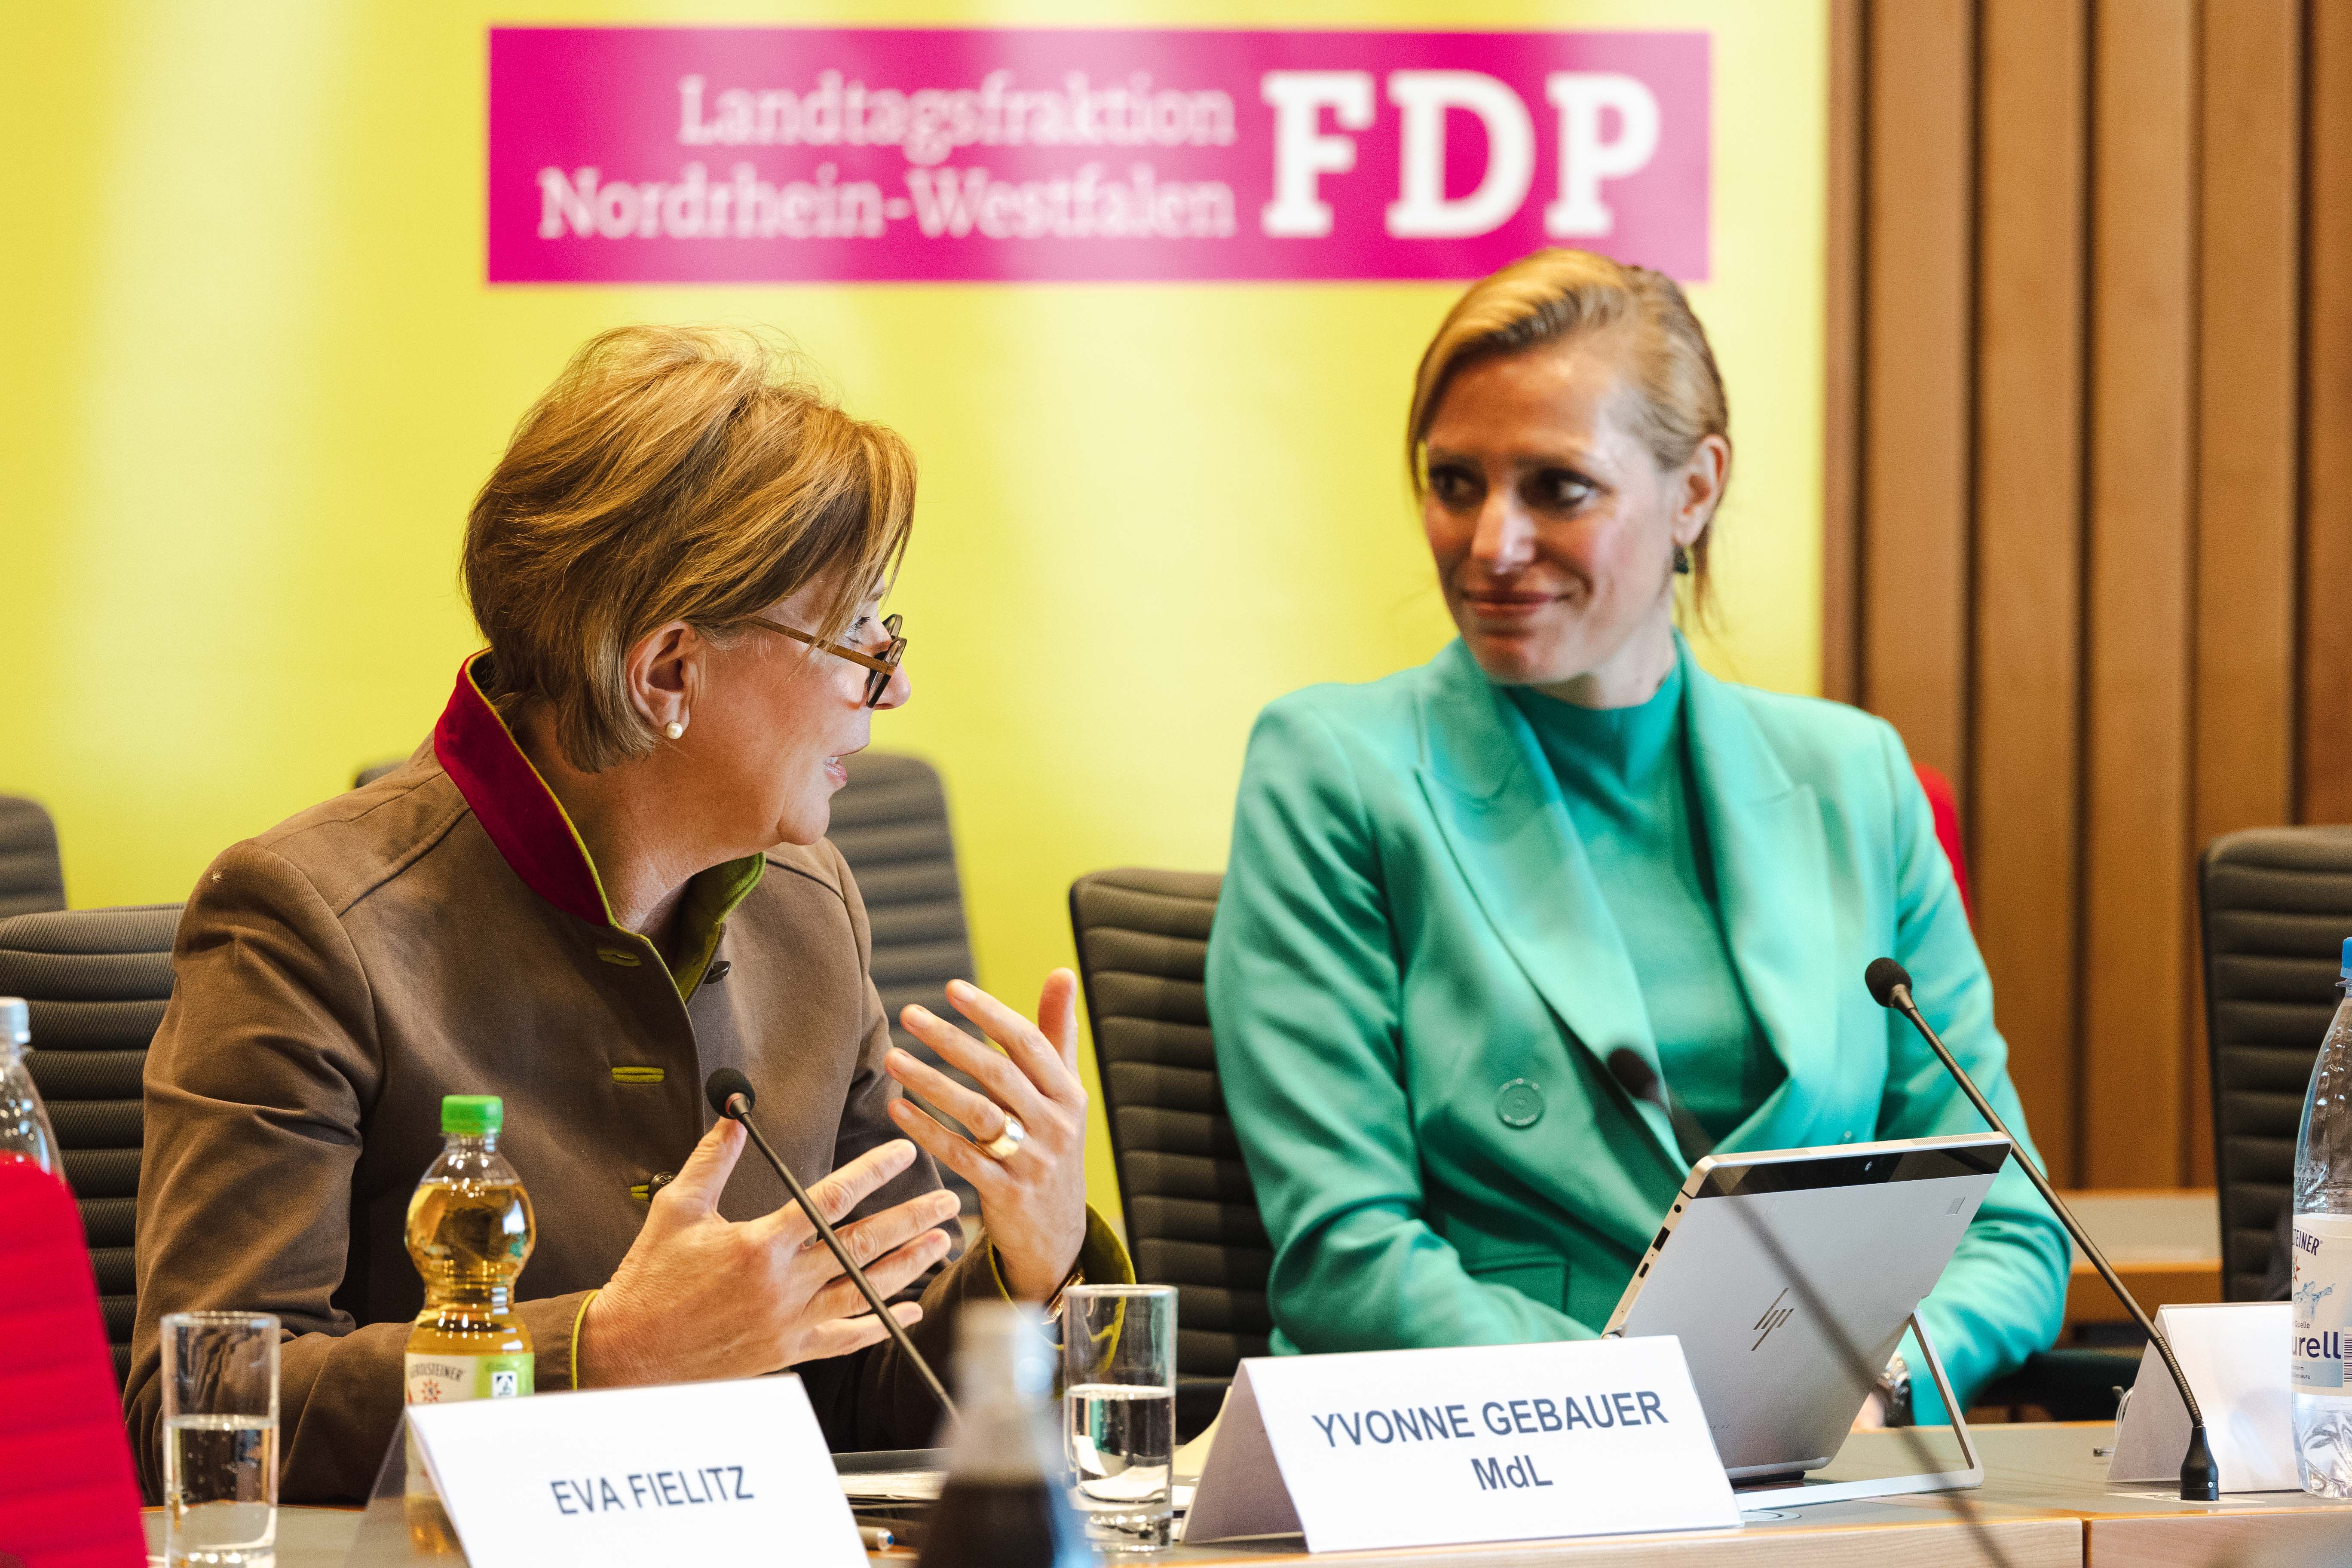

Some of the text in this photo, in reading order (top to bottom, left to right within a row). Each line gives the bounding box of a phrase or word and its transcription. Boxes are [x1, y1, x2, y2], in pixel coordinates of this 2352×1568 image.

[678, 69, 1237, 166] Landtagsfraktion
[1262, 70, 1660, 238] FDP
[538, 161, 1237, 239] Nordrhein-Westfalen
[1311, 1390, 1669, 1448] YVONNE GEBAUER
[550, 1465, 755, 1515] EVA FIELITZ
[1470, 1455, 1554, 1491] MdL
